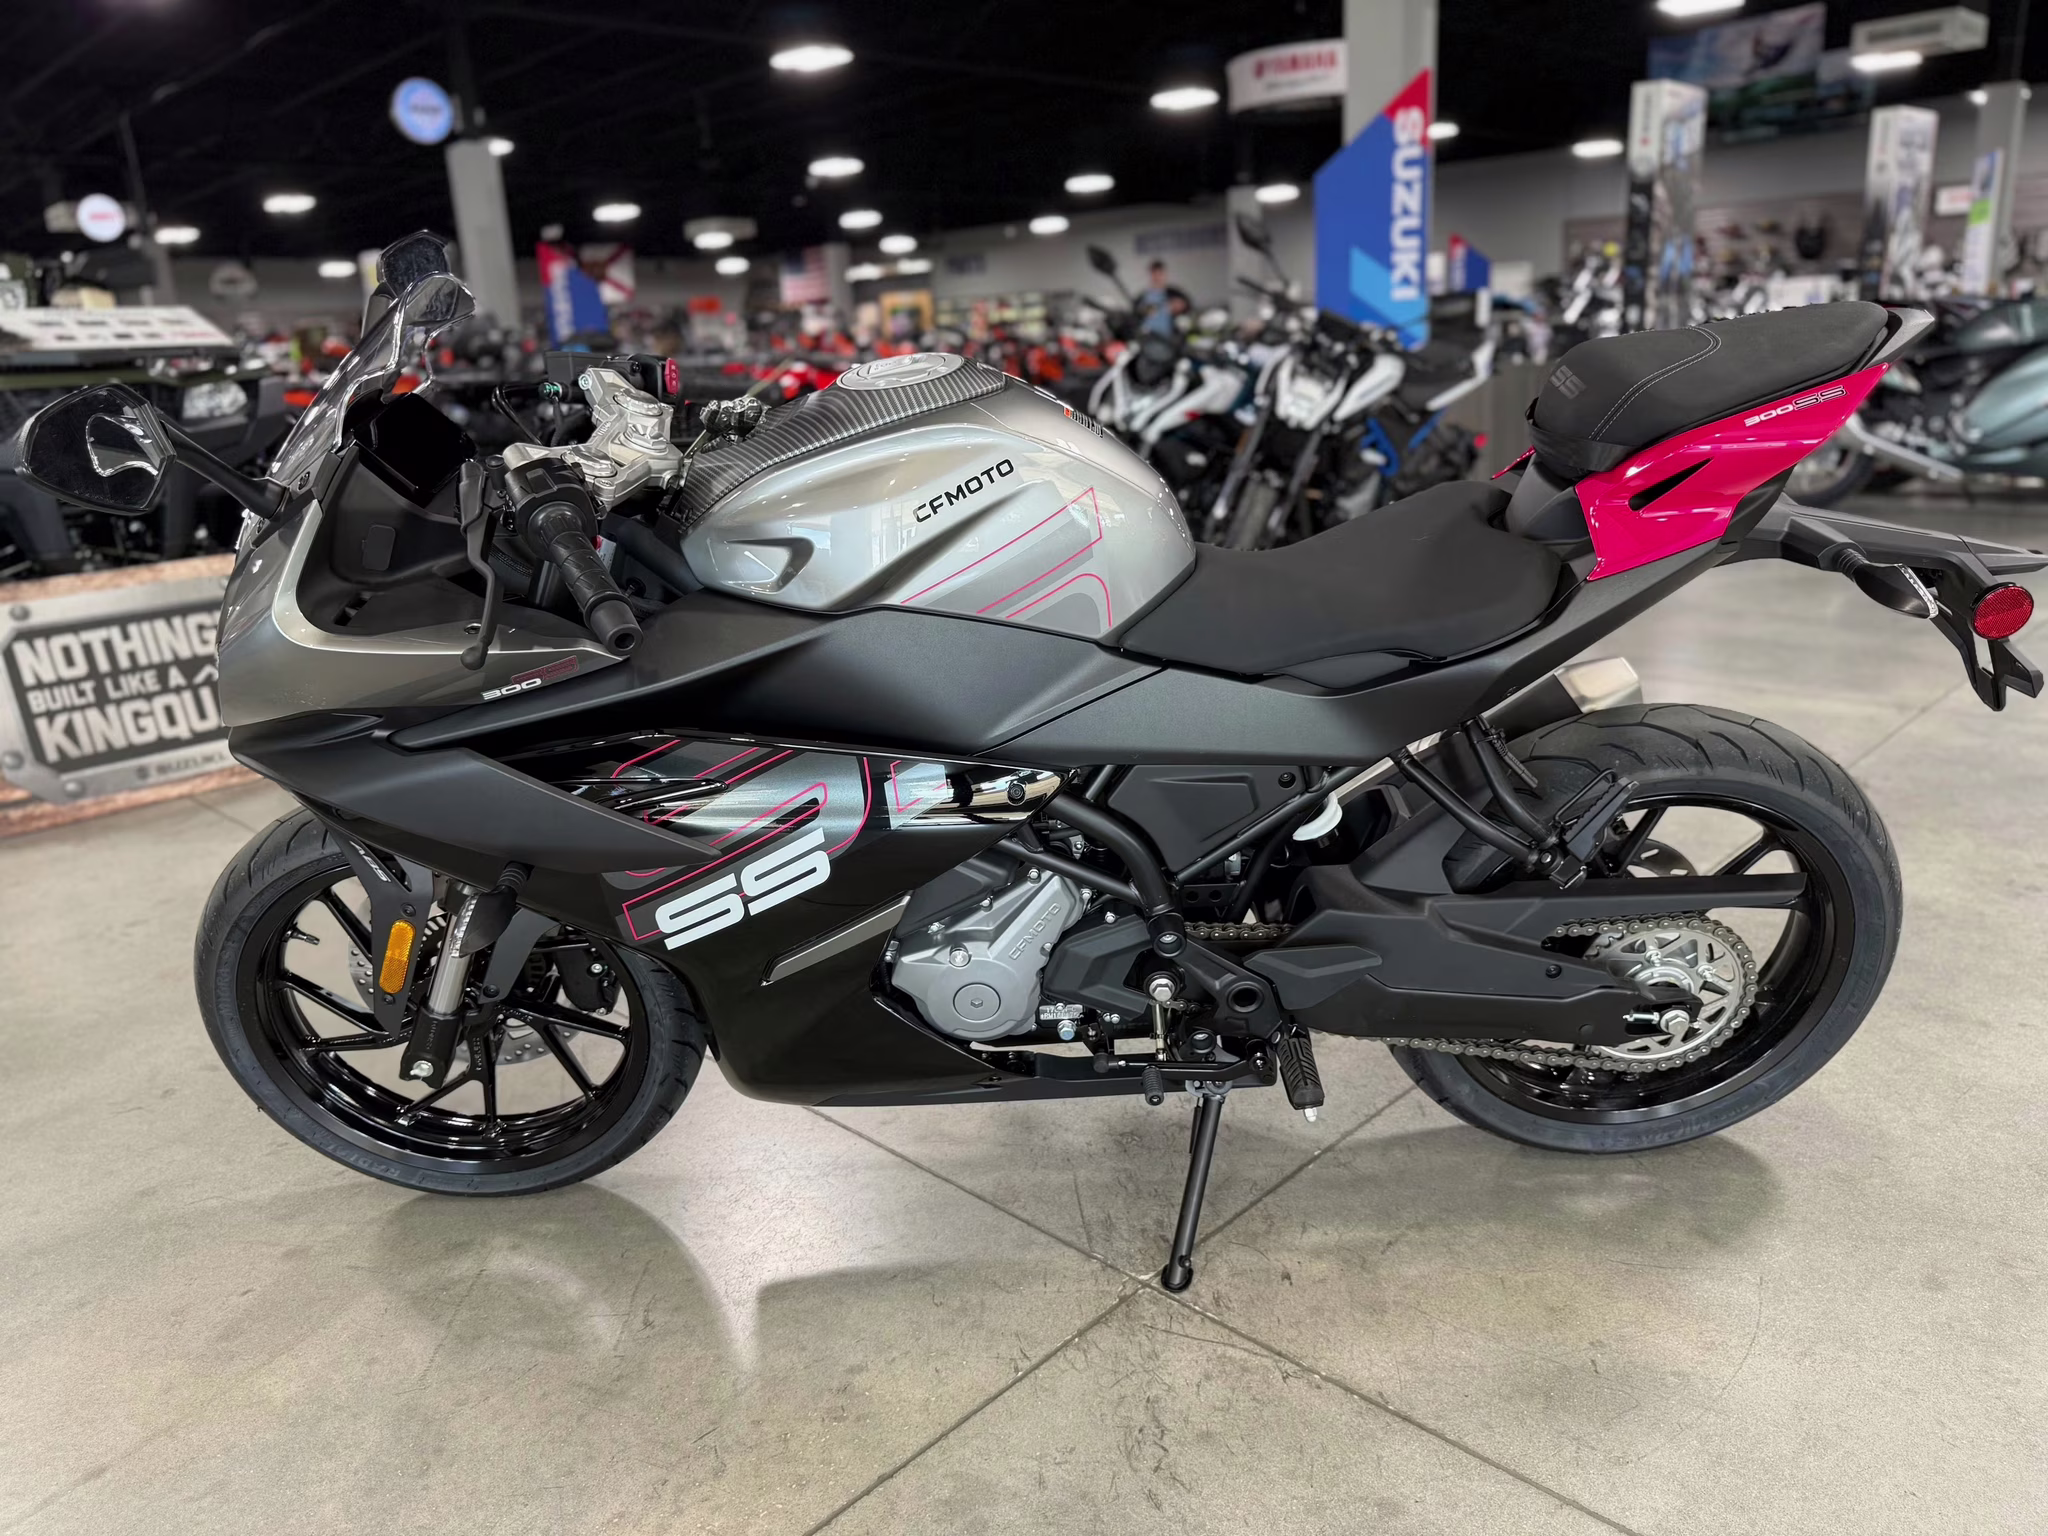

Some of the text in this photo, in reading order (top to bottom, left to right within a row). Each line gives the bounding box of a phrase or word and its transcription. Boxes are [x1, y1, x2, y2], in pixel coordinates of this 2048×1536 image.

[1390, 105, 1424, 302] SUZUKI
[913, 459, 1014, 522] CFMOTO
[26, 665, 187, 714] BUILT LIKE A
[34, 685, 222, 763] KINGQU
[349, 840, 391, 882] ABS
[655, 827, 830, 950] SS
[1008, 902, 1061, 960] CFMOTO
